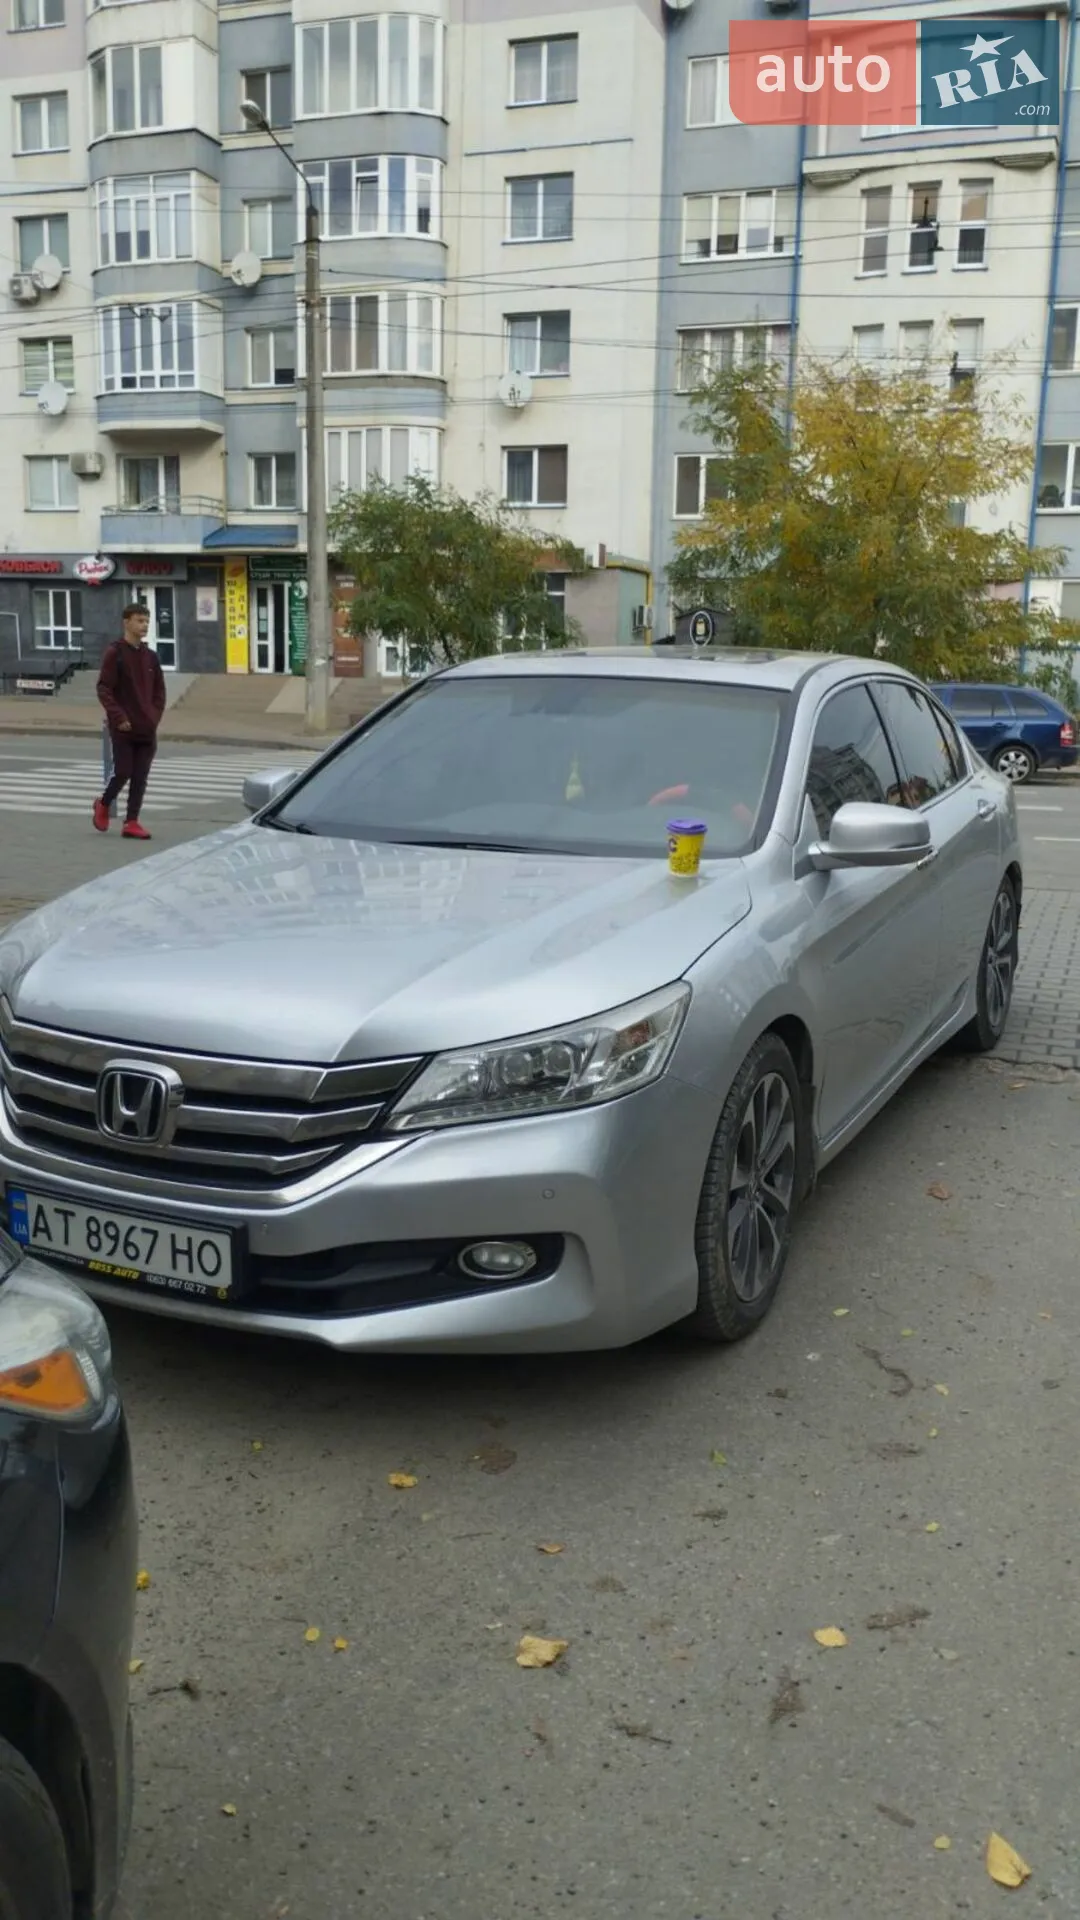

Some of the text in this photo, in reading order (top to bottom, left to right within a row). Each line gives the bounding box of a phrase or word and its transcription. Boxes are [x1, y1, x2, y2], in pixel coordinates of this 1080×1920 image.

[14, 1222, 28, 1235] UA
[32, 1203, 222, 1278] AT 8967 HO
